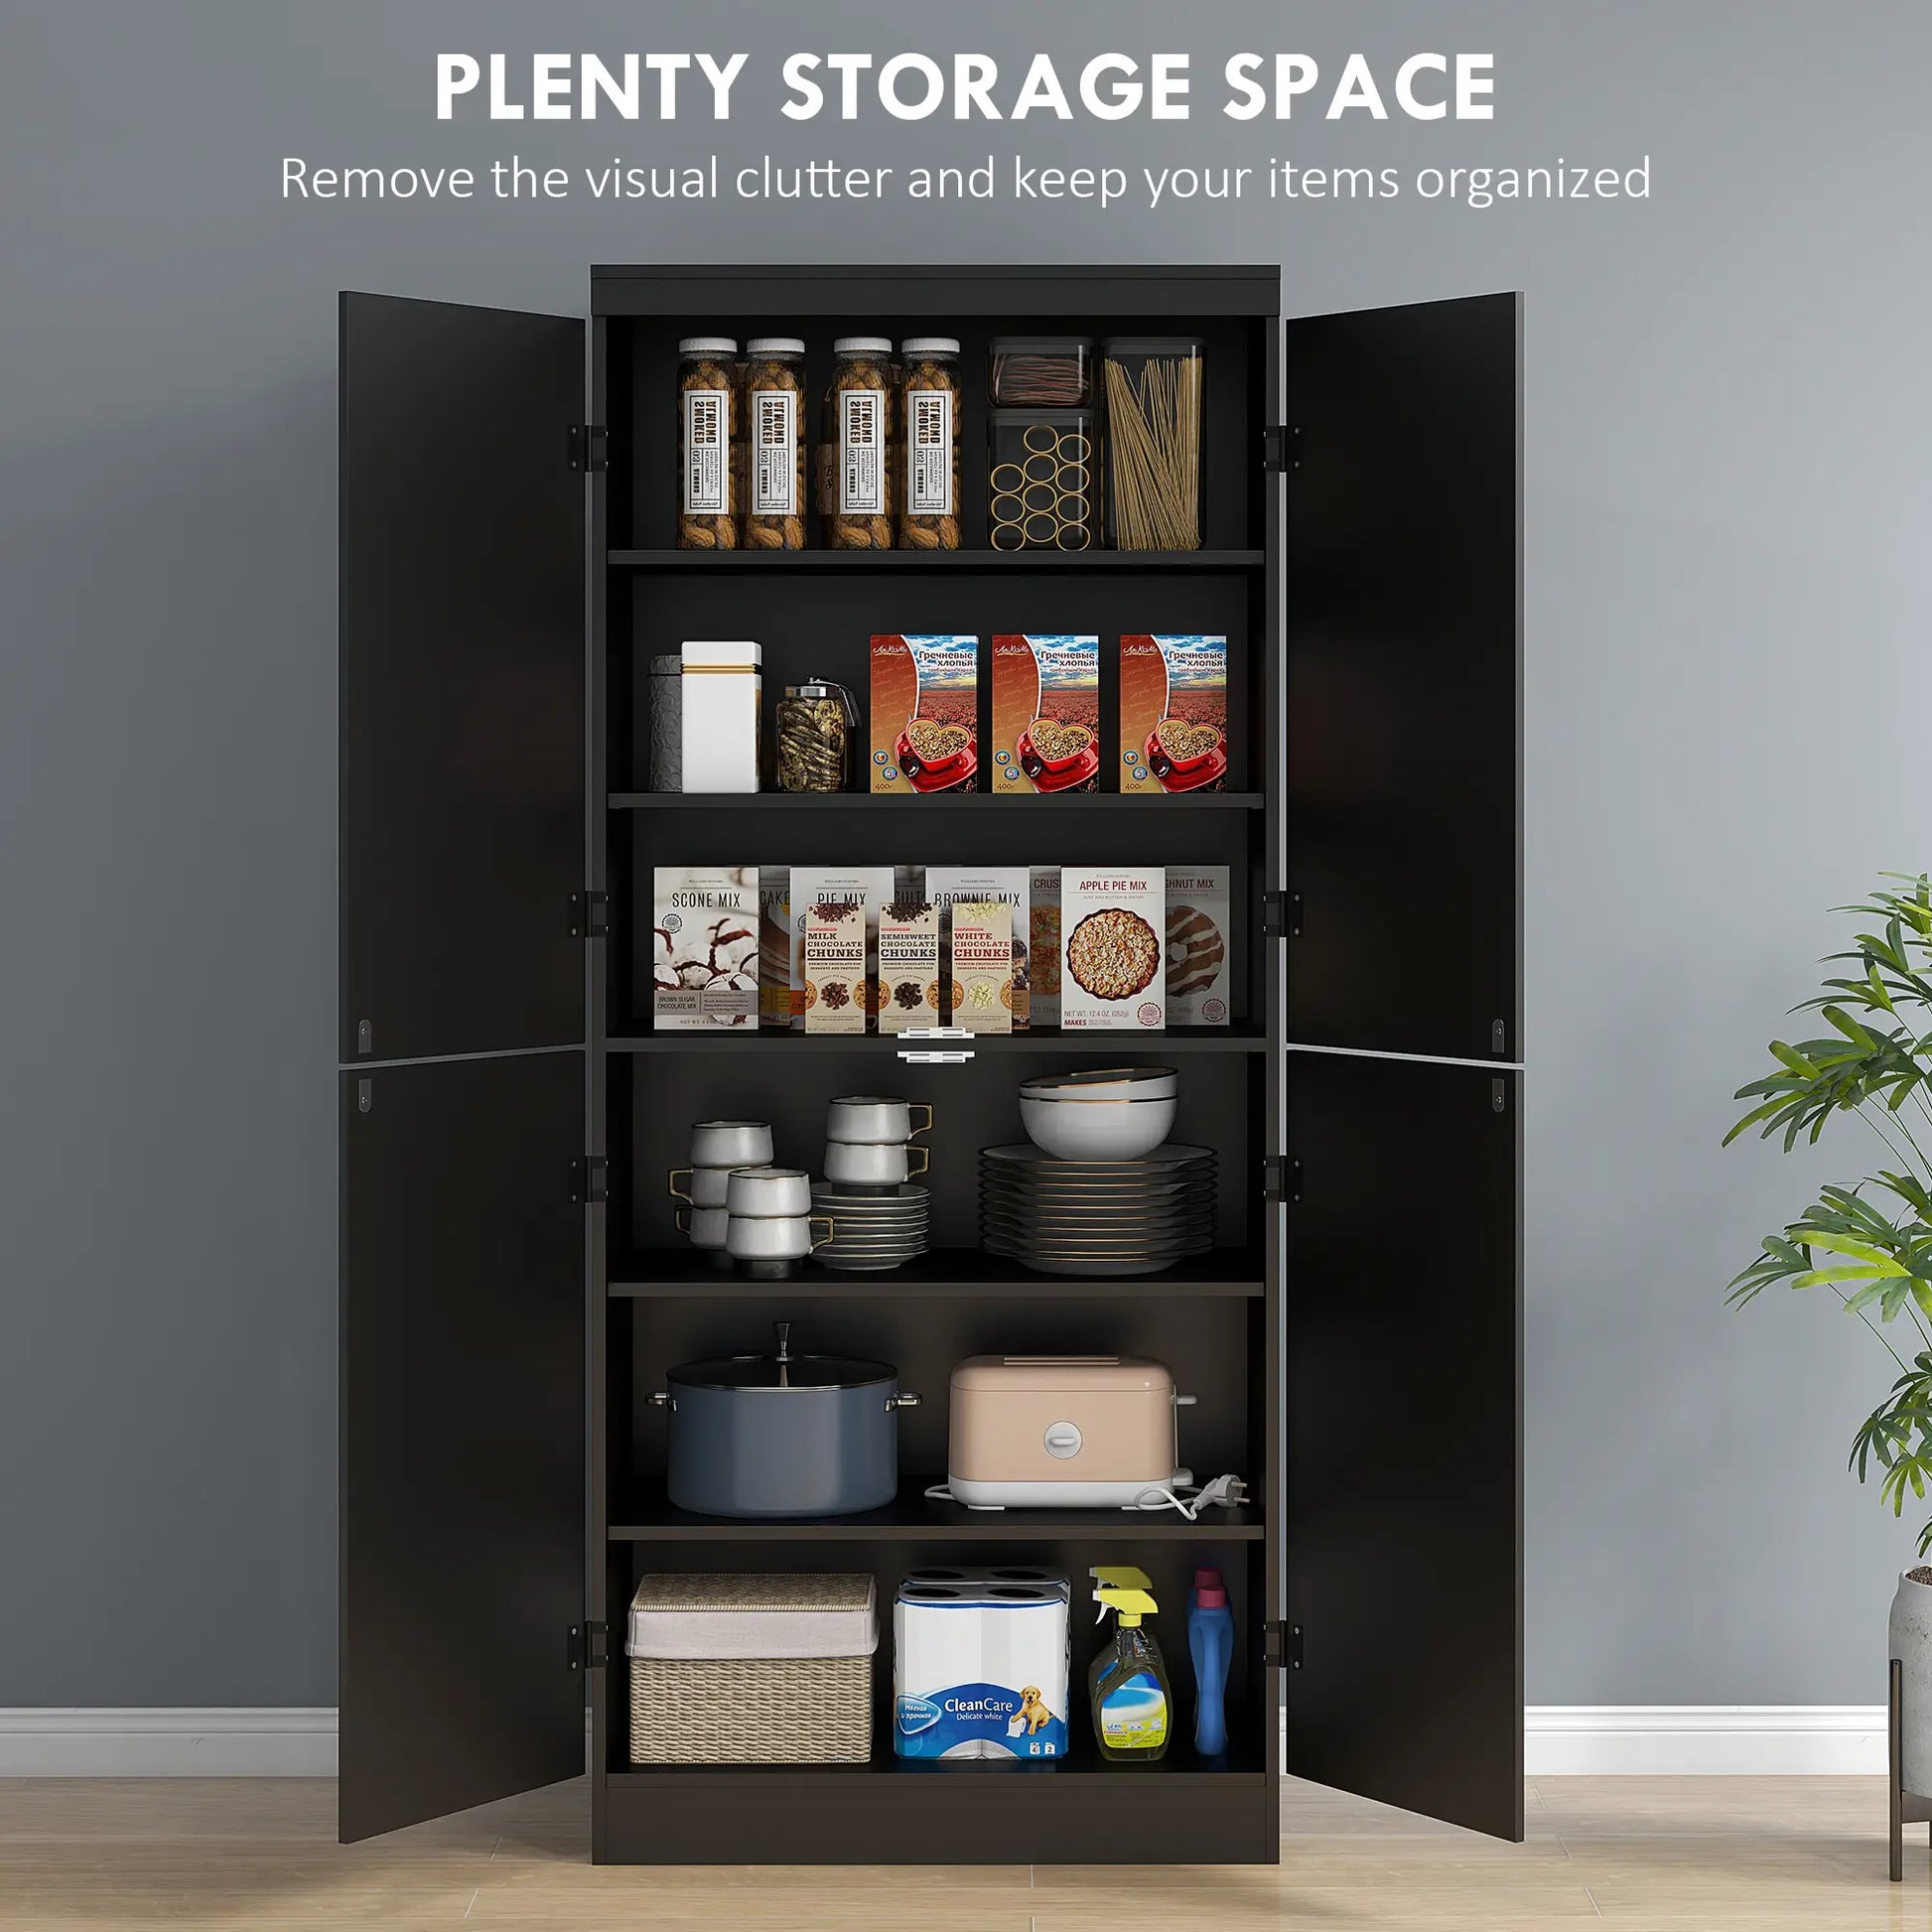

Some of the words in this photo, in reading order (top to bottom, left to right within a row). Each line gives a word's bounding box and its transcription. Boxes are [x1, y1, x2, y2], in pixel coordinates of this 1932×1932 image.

[919, 651, 973, 660] Гречневые
[1040, 651, 1095, 660] Гречневые
[1169, 651, 1223, 660] Гречневые
[1080, 881, 1109, 891] APPLE
[1112, 881, 1127, 891] PIE
[1130, 881, 1148, 891] MIX
[1197, 879, 1214, 889] MIX
[672, 893, 713, 907] SCONE
[718, 893, 741, 907] MIX
[818, 893, 837, 904] PIE
[844, 893, 866, 905] MIX
[934, 893, 991, 907] BROWNIE
[999, 893, 1021, 907] MIX
[944, 1698, 1014, 1712] CleanCare
